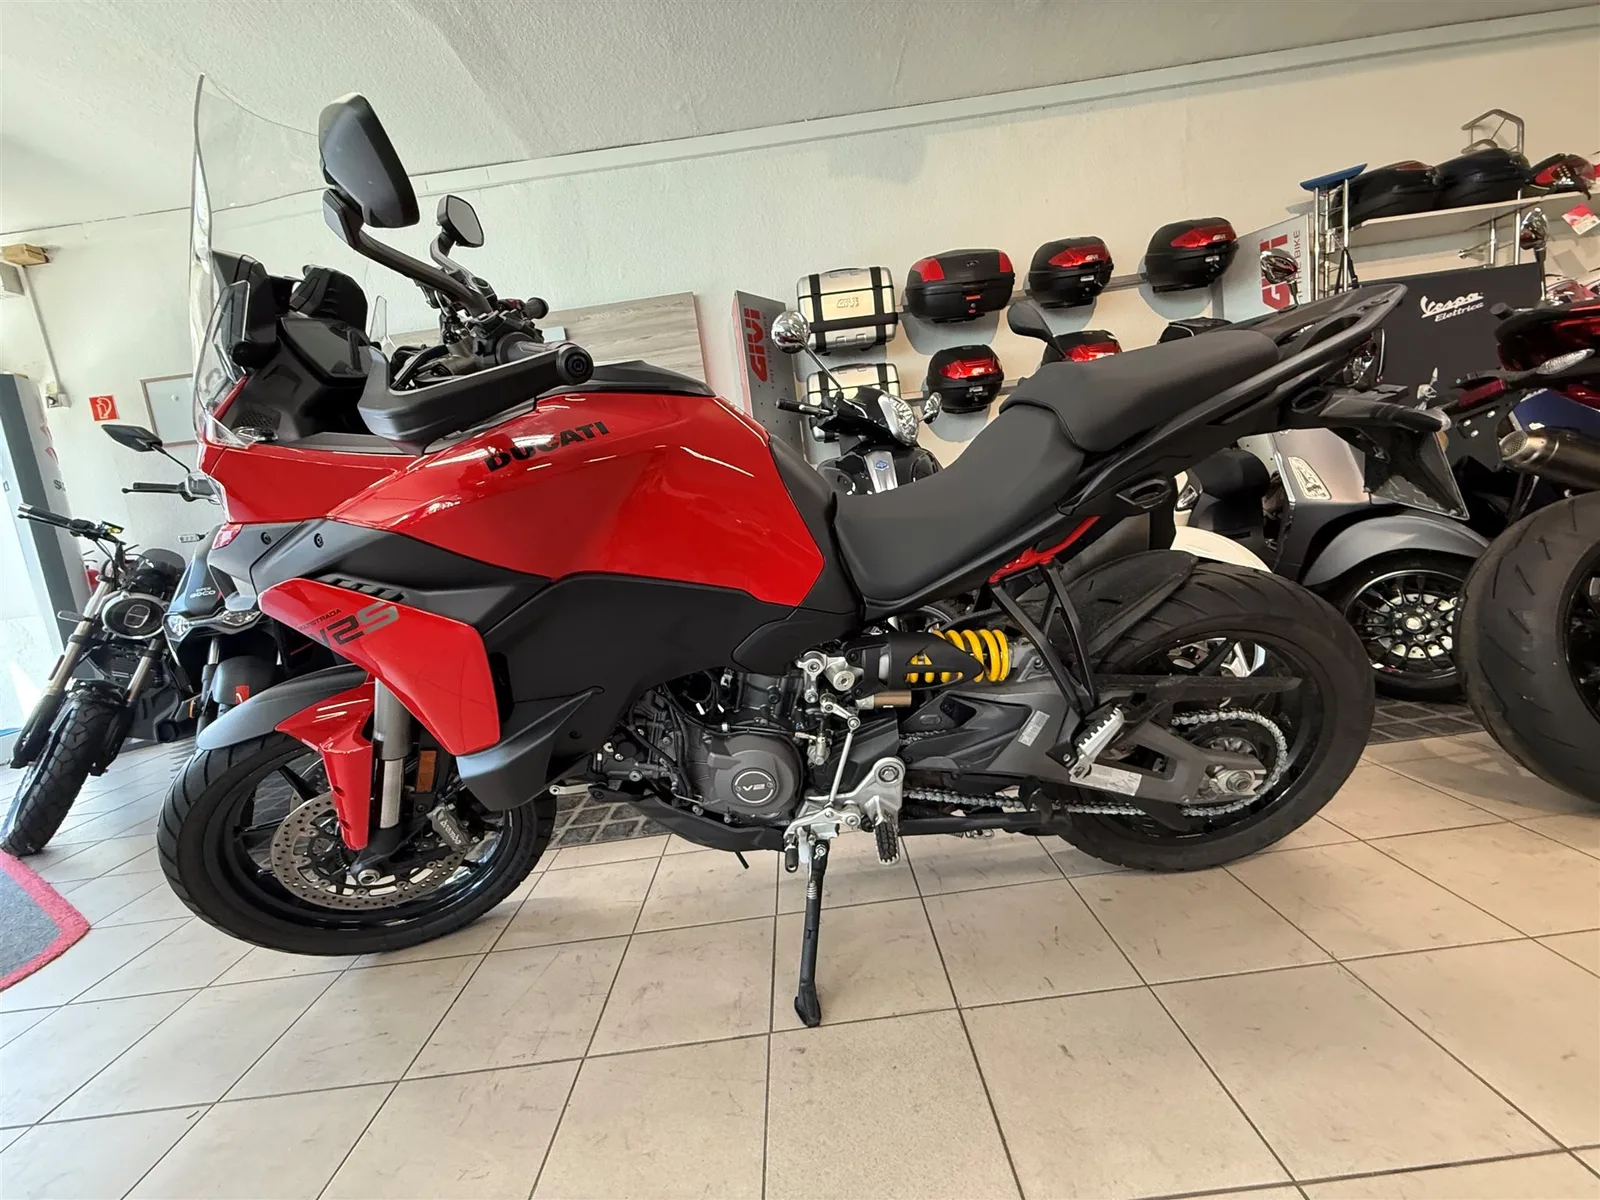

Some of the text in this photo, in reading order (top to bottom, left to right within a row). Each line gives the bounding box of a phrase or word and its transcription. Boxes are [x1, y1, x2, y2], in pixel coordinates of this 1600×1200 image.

[1293, 229, 1302, 259] BIKE
[1259, 234, 1288, 310] GI
[836, 297, 859, 308] GIVI
[1420, 295, 1484, 318] Vespa
[1434, 302, 1484, 322] Elettrica
[743, 308, 768, 382] GIVI
[483, 420, 610, 473] DUCATI
[309, 601, 400, 647] V2S
[742, 783, 765, 791] V2
[440, 819, 462, 845] brembo
